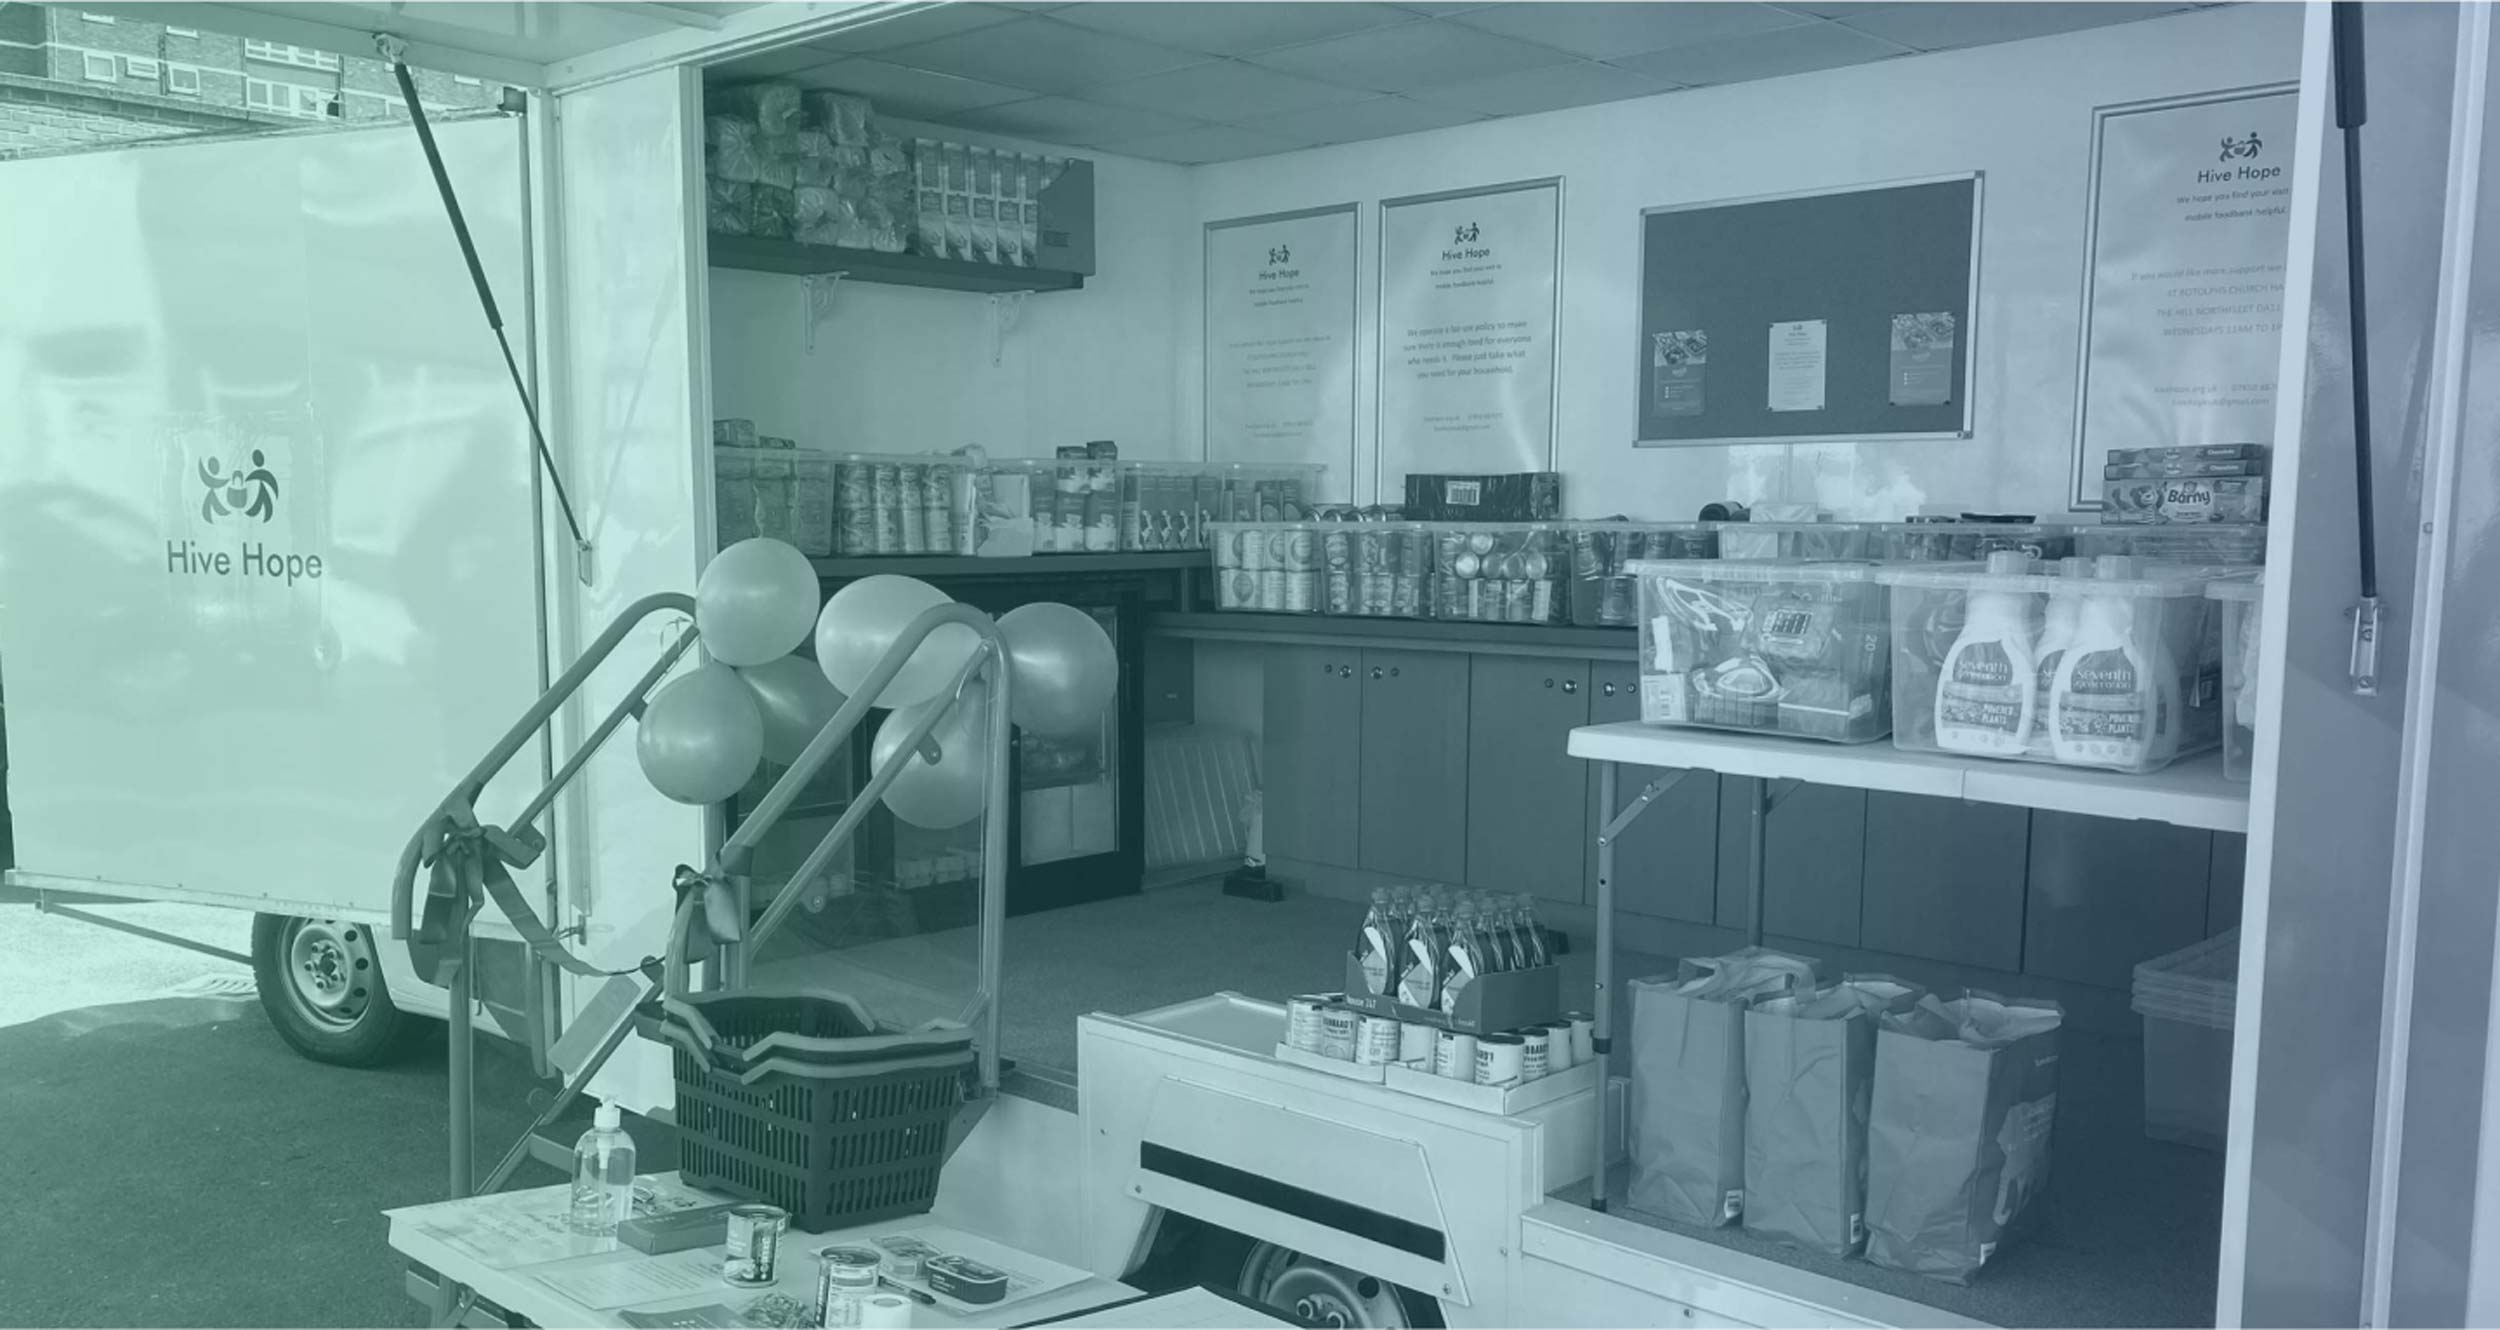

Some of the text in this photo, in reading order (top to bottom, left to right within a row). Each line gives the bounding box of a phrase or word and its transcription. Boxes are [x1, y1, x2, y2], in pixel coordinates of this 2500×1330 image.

[2197, 166, 2281, 184] Hive Hope
[2232, 190, 2248, 199] find
[2250, 190, 2270, 199] your
[1442, 248, 1490, 260] Hive Hope
[1259, 268, 1300, 280] Hive Hope
[1484, 336, 1496, 345] for
[2168, 488, 2211, 505] Barny
[167, 540, 322, 587] Hive Hope
[1958, 660, 2008, 674] seventh
[2076, 669, 2132, 681] seventh
